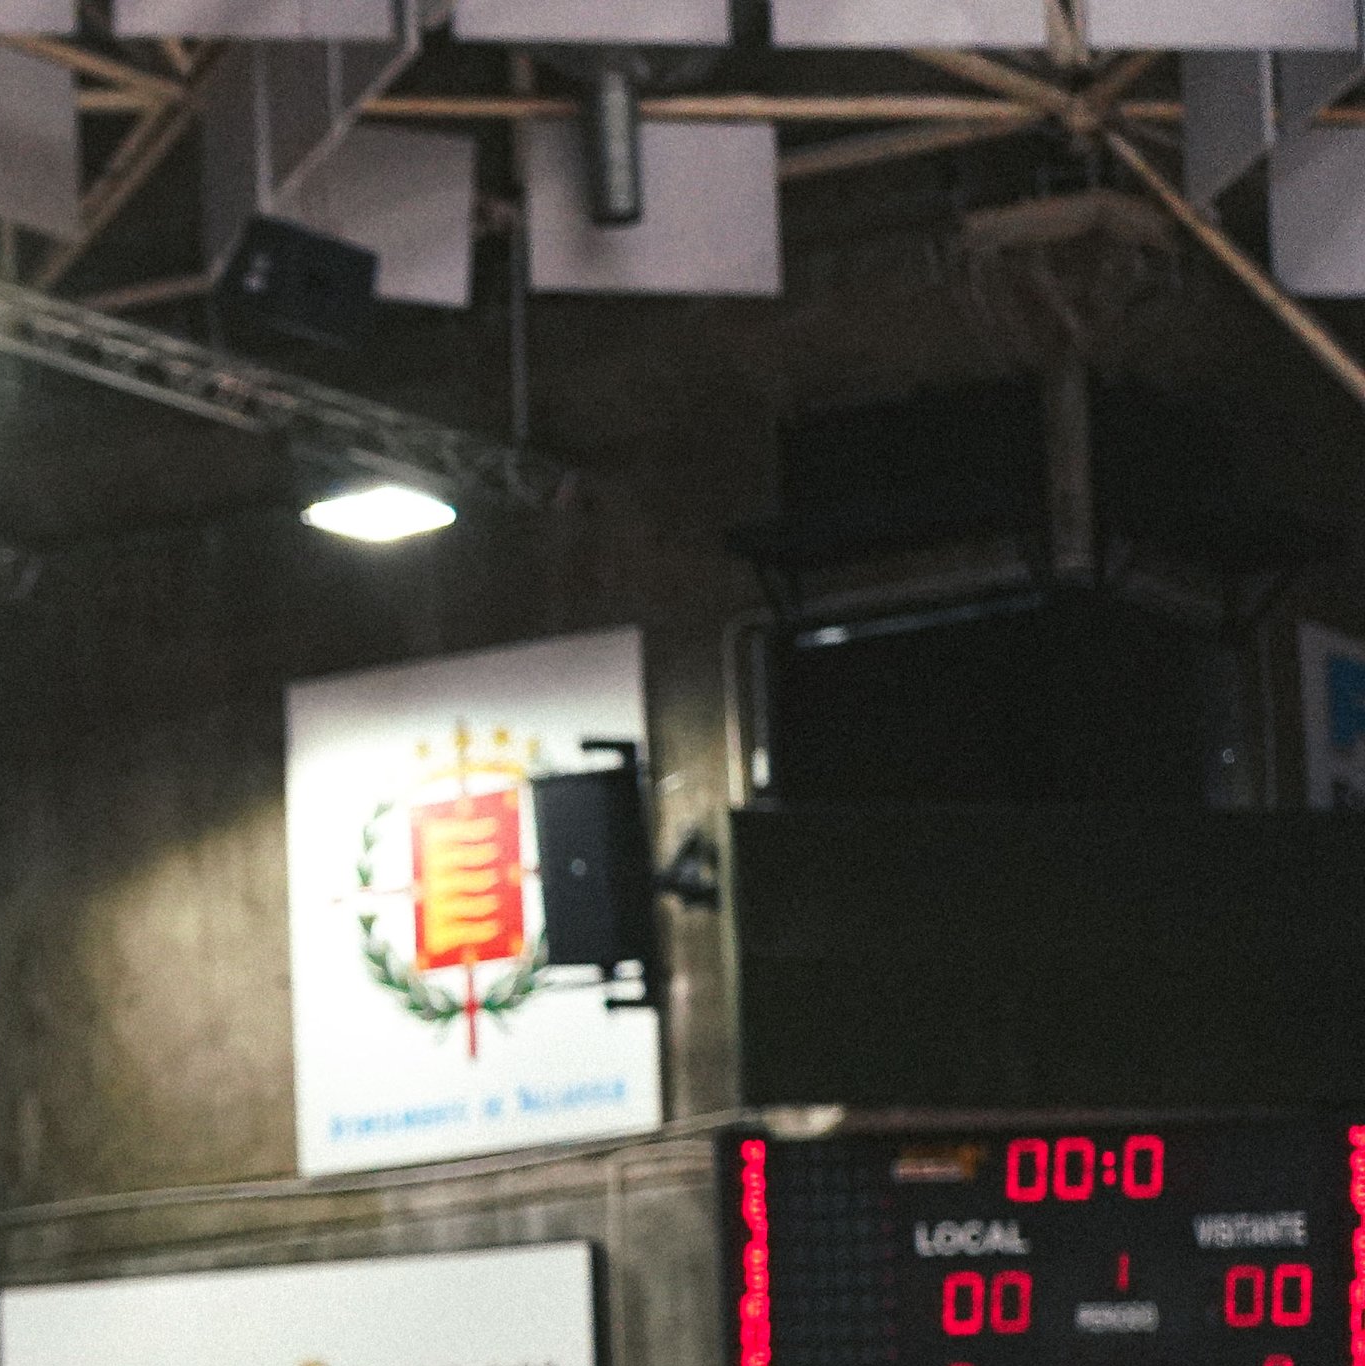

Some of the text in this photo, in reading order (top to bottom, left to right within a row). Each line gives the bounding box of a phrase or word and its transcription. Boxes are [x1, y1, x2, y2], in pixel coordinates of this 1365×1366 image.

[1005, 1133, 1165, 1203] 00:0
[914, 1219, 1030, 1258] LOCAL
[941, 1269, 1033, 1337] 00
[1223, 1262, 1314, 1328] 00
